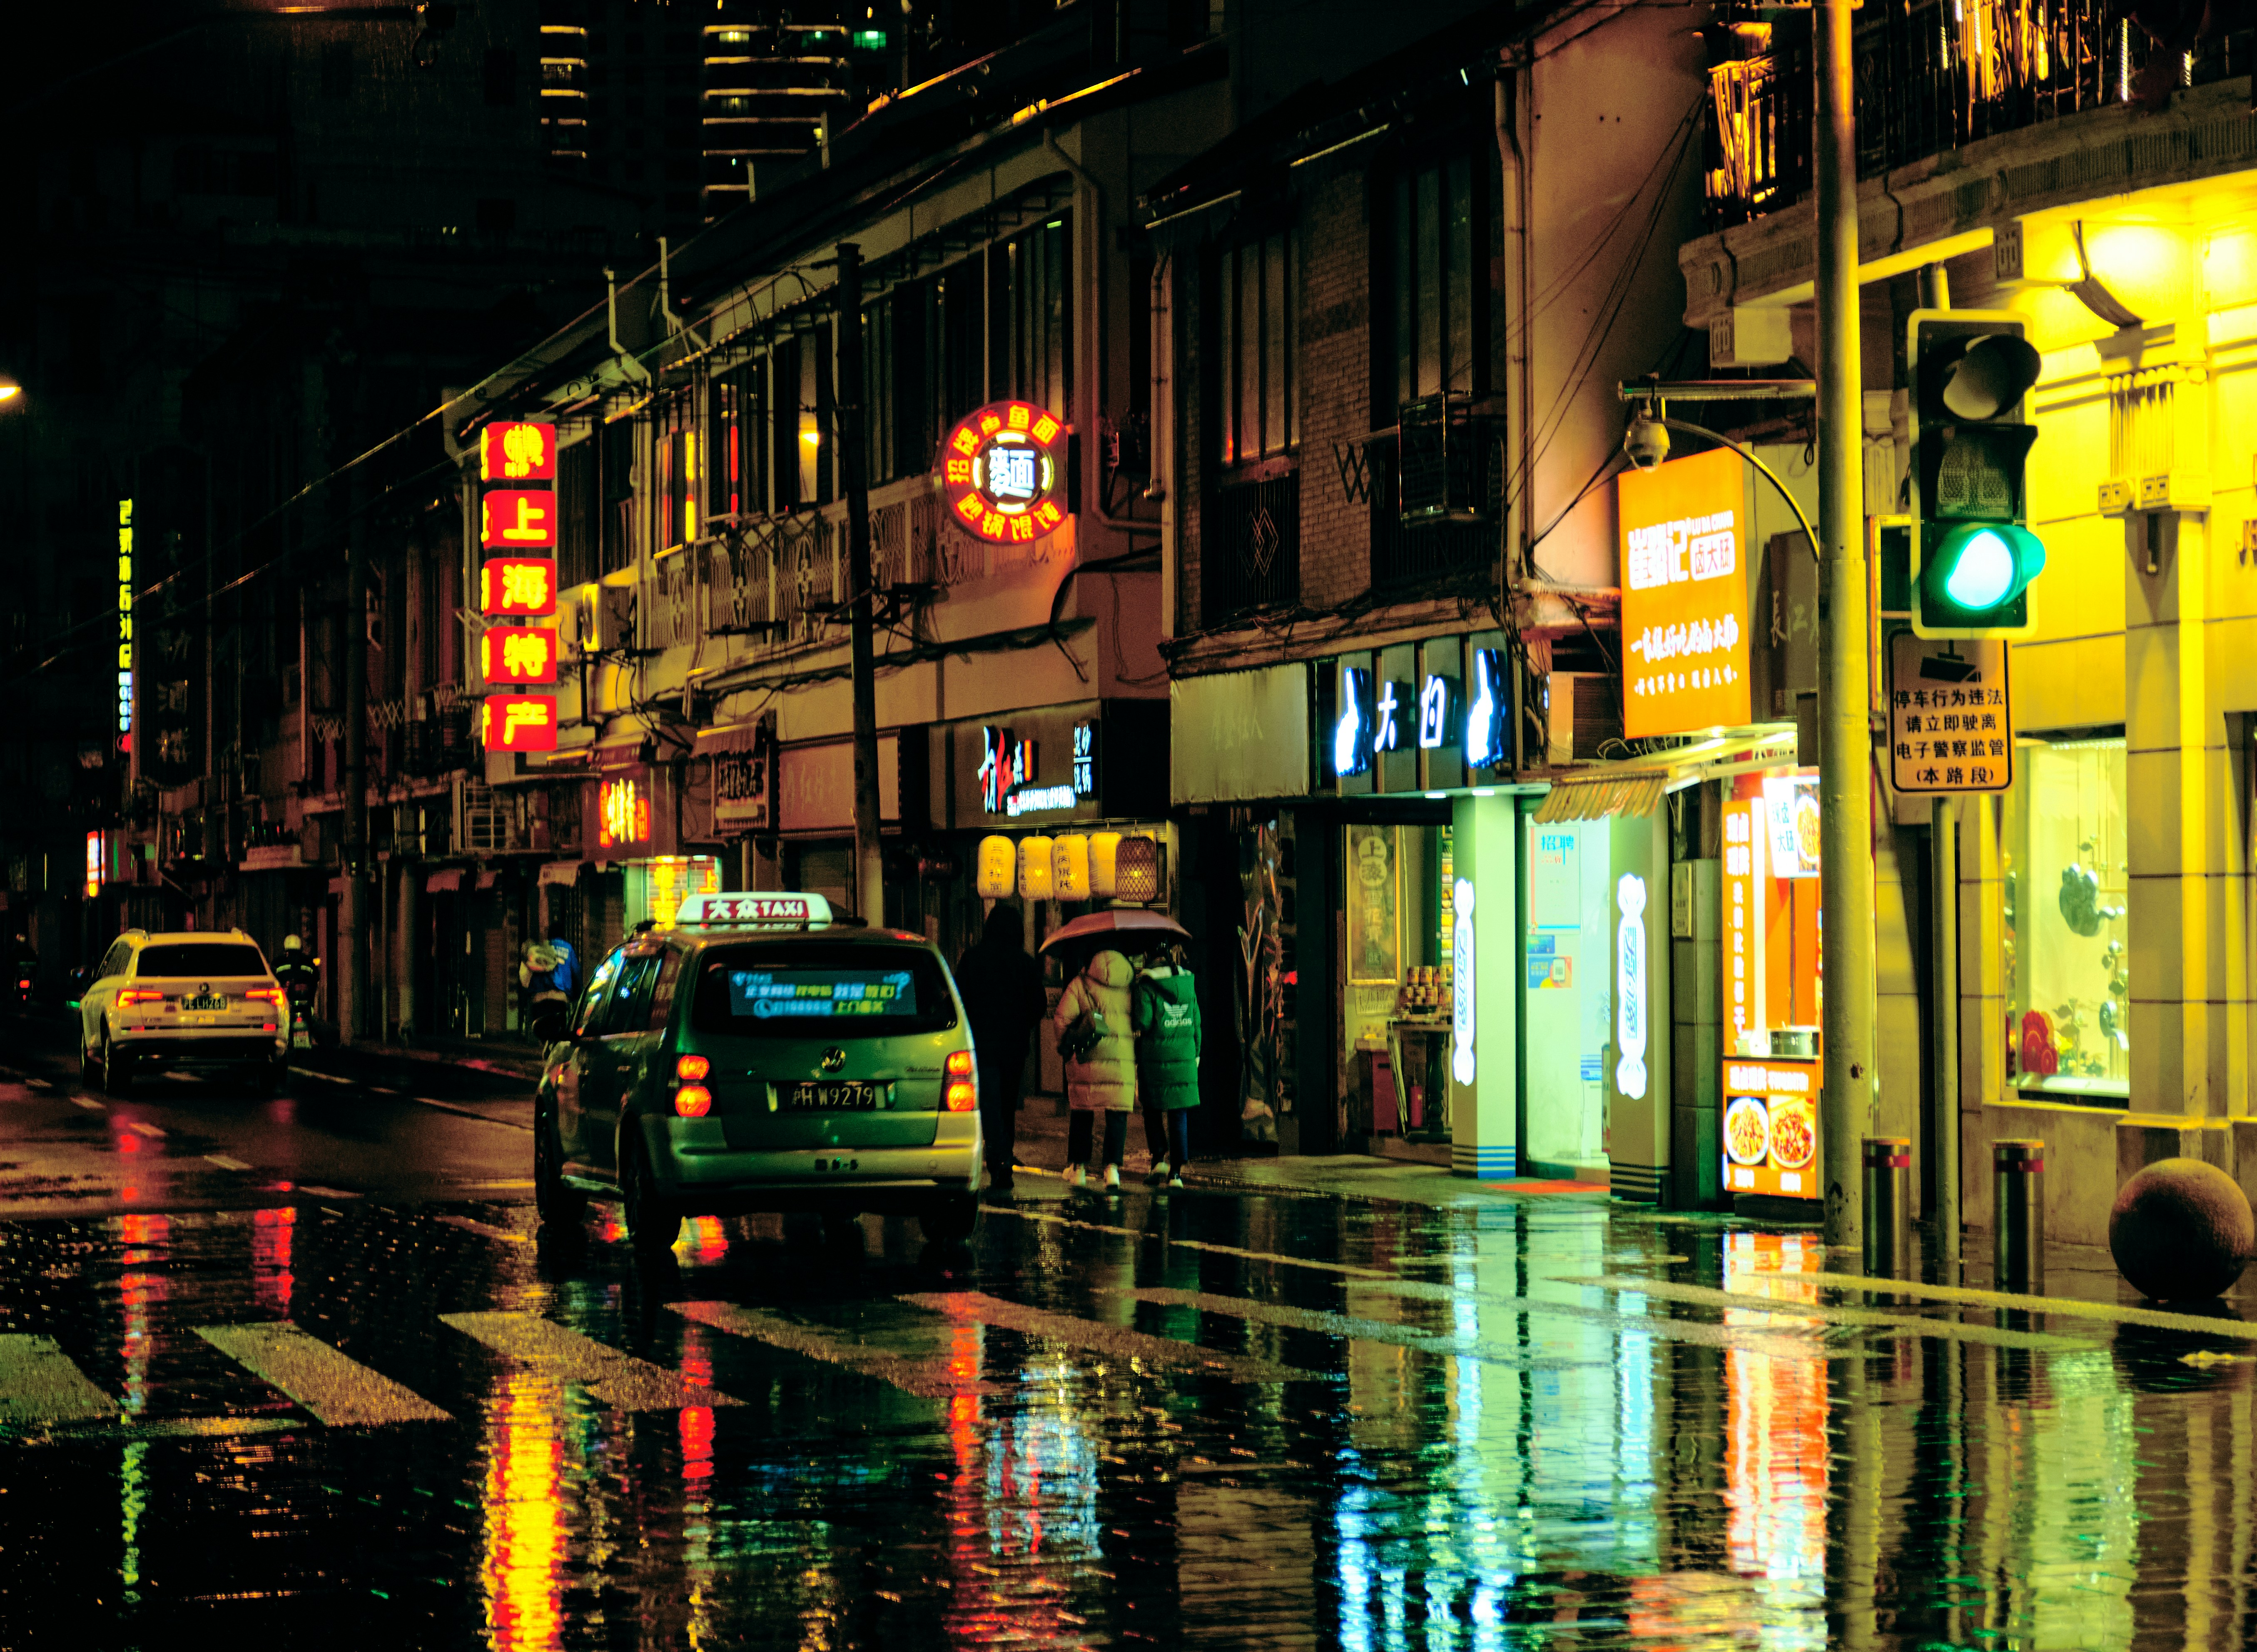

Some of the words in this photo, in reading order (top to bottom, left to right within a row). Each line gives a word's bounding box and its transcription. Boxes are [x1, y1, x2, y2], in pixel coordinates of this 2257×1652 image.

[957, 493, 1061, 541] 砂锅馄饨
[1692, 518, 1701, 536] LU
[1701, 516, 1711, 533] DA
[1711, 510, 1734, 531] CHANG
[1695, 538, 1730, 575] 卤大肠
[503, 498, 548, 745] 上海特产
[1894, 688, 2003, 709] 停车行为违法
[1906, 713, 1996, 733] 请立即驶离
[1896, 738, 2004, 760] 电子警察监管
[1916, 766, 1994, 785] (本路段)
[1771, 802, 1789, 824] 现卤
[1541, 835, 1574, 859] 招聘
[1777, 830, 1795, 852] 大肠
[1057, 842, 1072, 891] 菜肉馄饨
[709, 899, 759, 919] 大众
[761, 901, 804, 917] TAXI
[1164, 1018, 1192, 1028] adidas
